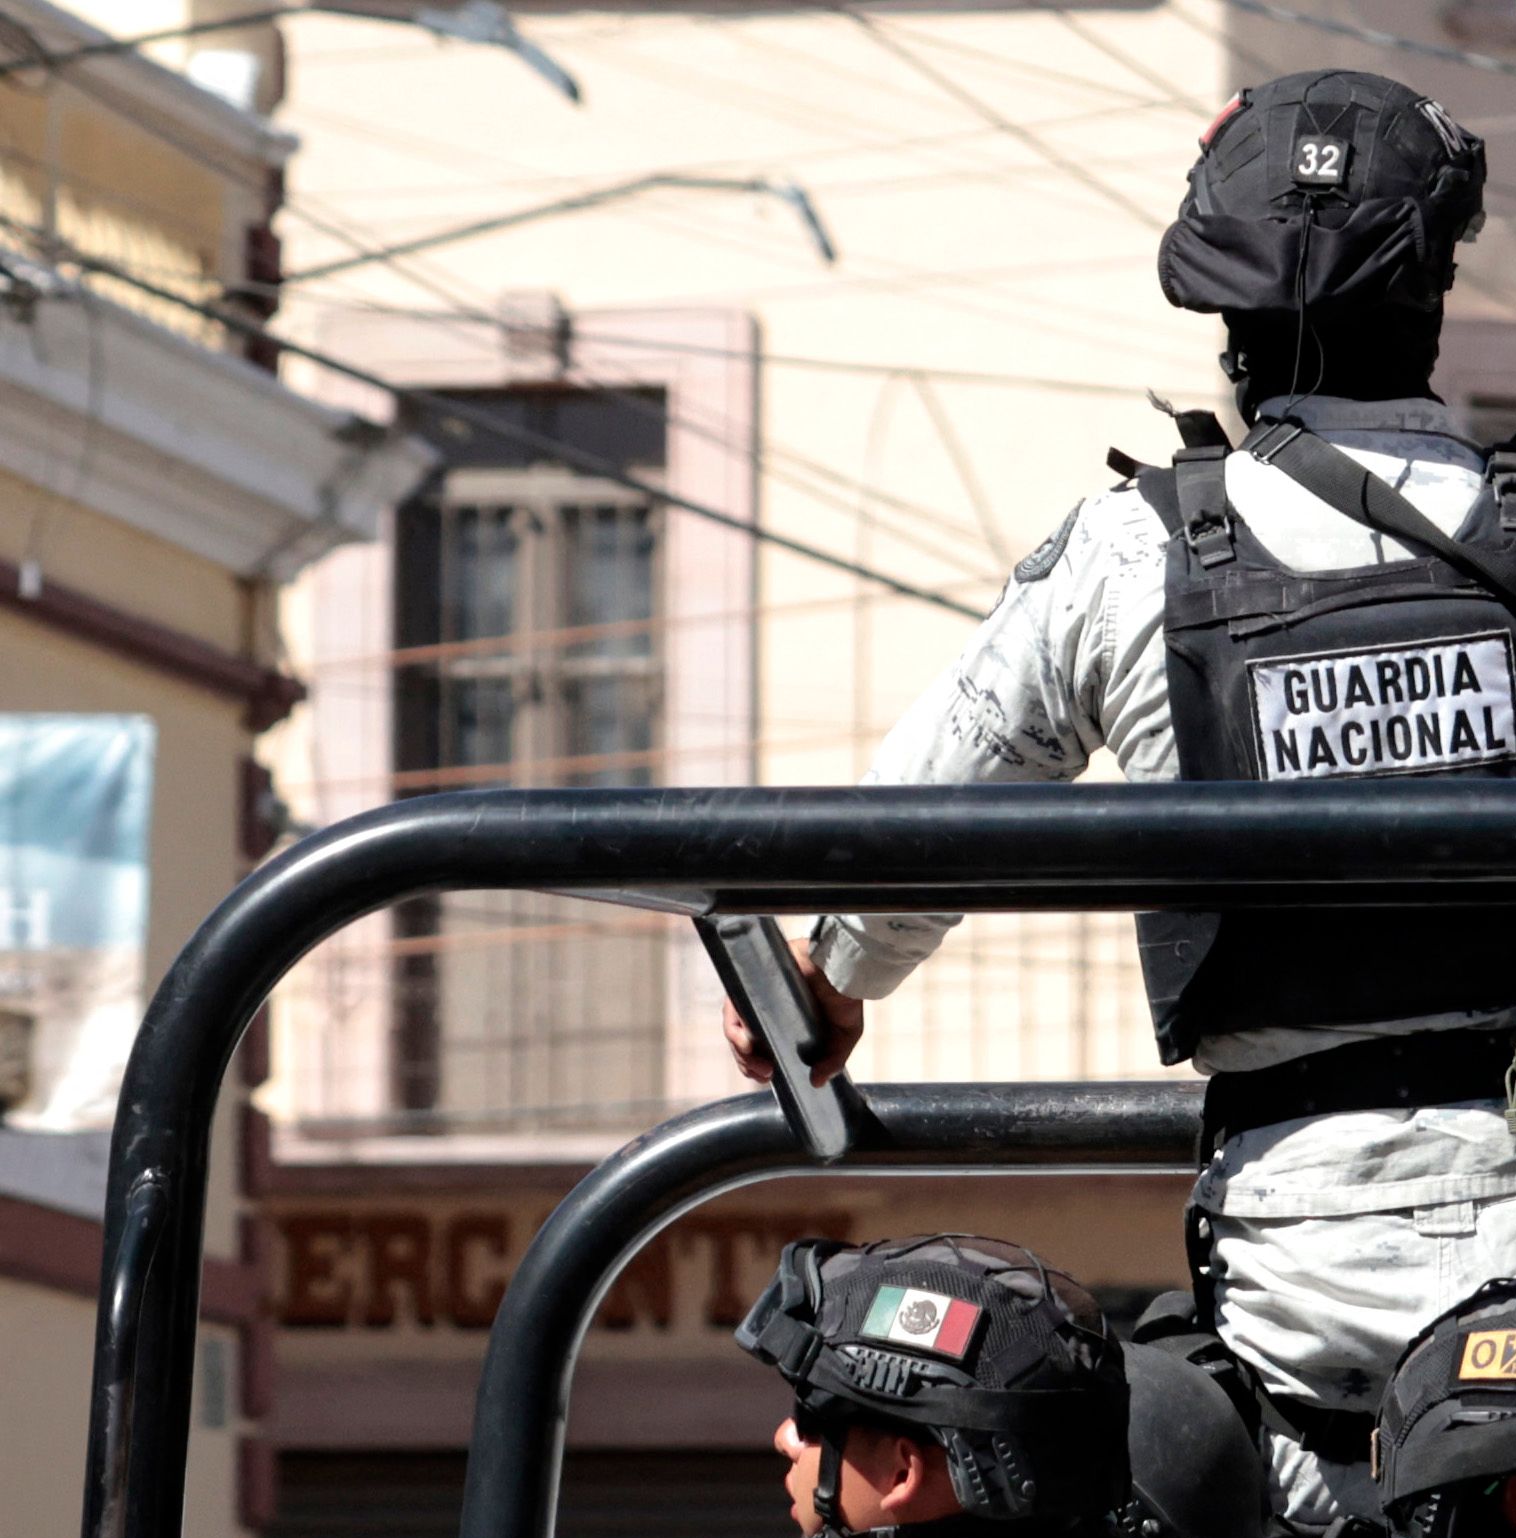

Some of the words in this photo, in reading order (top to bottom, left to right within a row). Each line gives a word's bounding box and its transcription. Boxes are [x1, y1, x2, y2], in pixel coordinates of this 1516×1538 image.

[1298, 143, 1340, 177] 32
[1284, 651, 1482, 715] GUARDIA
[1272, 706, 1506, 773] NACIONAL
